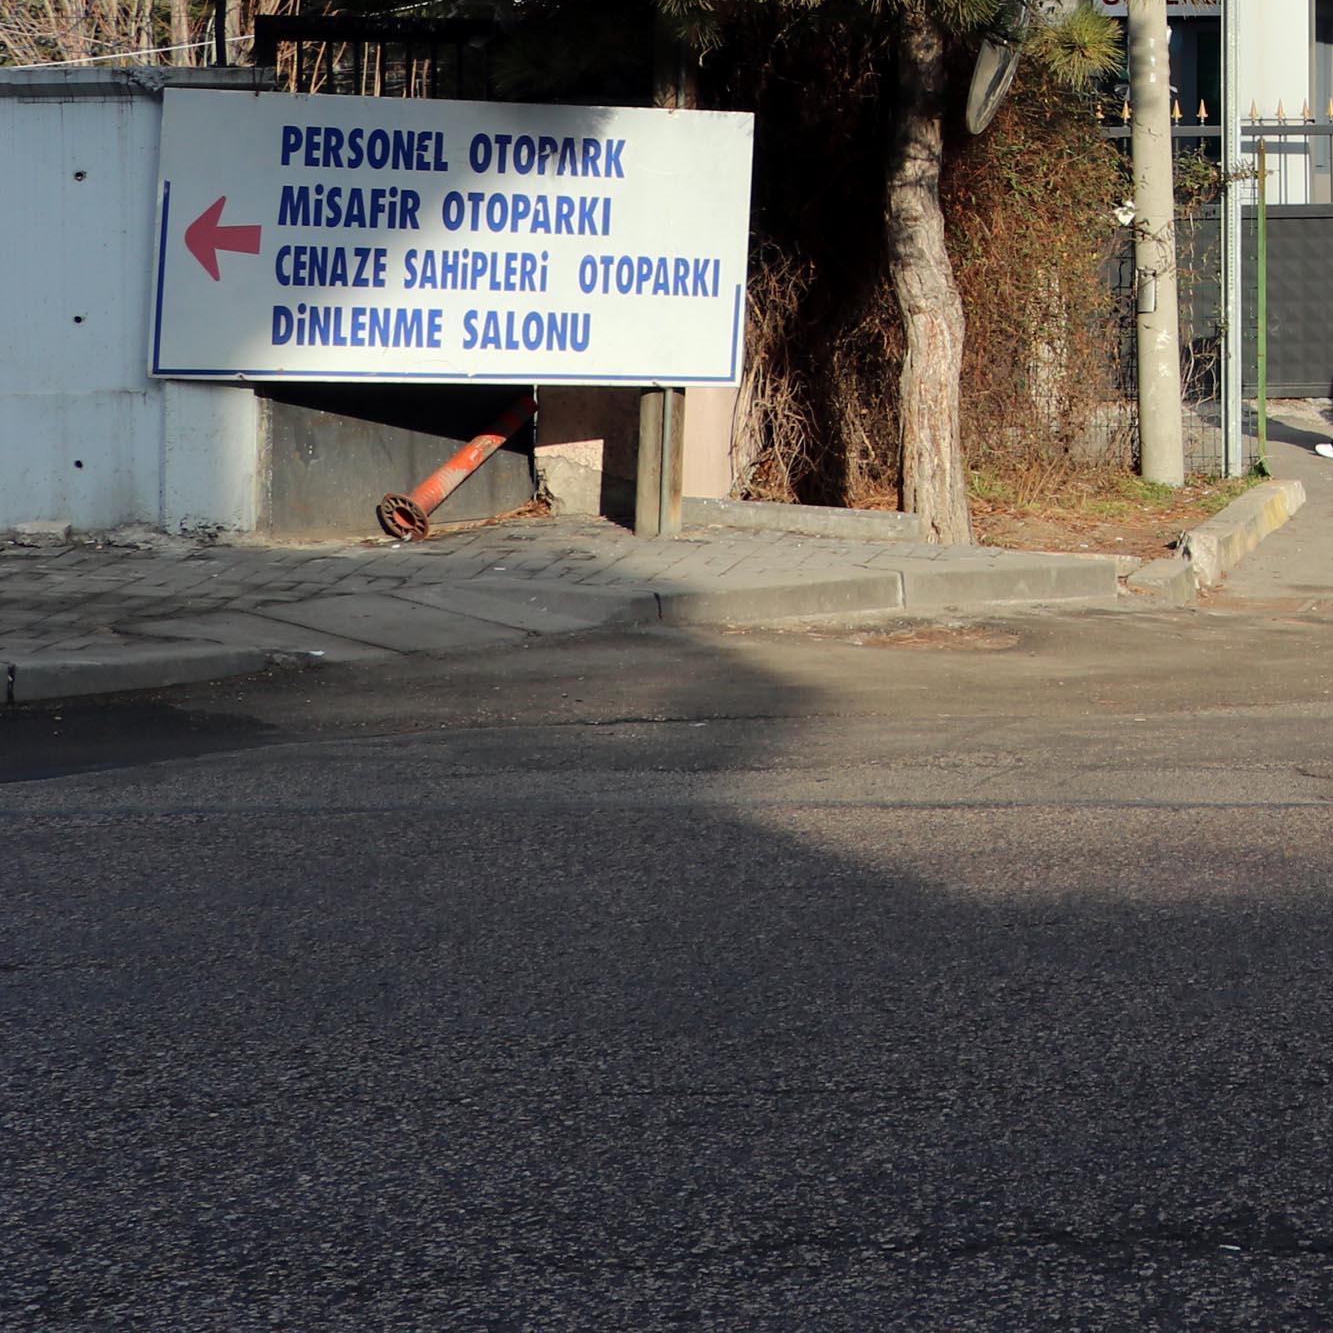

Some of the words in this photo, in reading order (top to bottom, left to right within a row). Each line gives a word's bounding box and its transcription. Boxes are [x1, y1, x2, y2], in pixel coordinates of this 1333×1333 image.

[281, 125, 448, 171] PERSONEL
[470, 133, 625, 178] OTOPARK
[442, 191, 611, 235] OTOPARKI
[275, 244, 387, 287] CENAZE
[579, 255, 719, 297] OTOPARKI
[463, 309, 590, 352] SALONU
